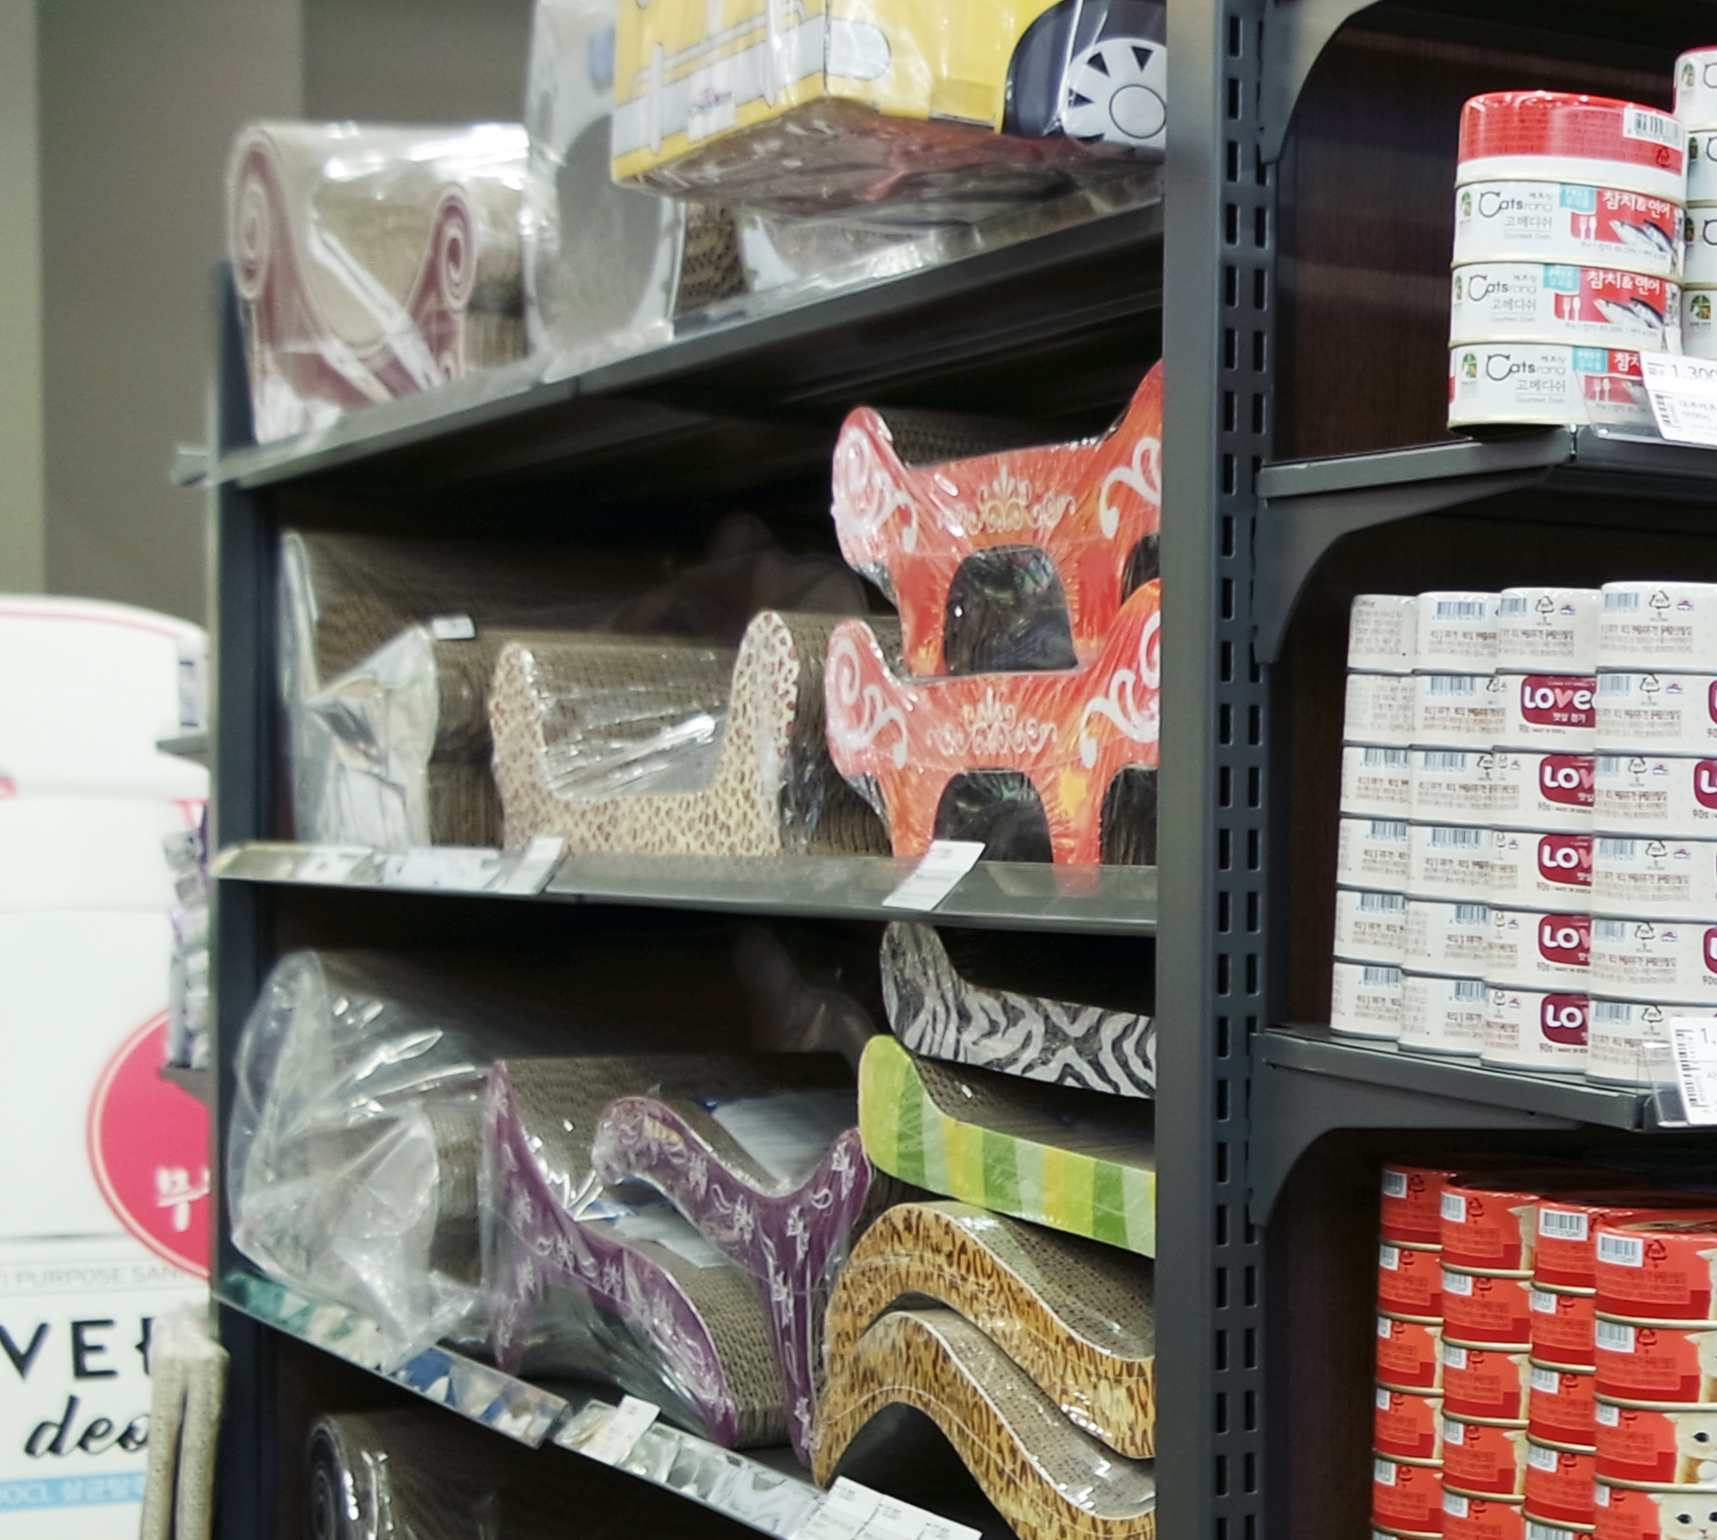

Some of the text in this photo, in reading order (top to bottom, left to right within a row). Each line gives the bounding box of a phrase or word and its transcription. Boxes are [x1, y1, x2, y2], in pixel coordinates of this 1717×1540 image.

[1603, 191, 1671, 218] 참치&연어
[1587, 270, 1661, 295] 참치&연어
[1491, 299, 1537, 312] 고메디쉬
[1516, 380, 1566, 393] 고메디쉬
[16, 1266, 125, 1286] PURPOSE
